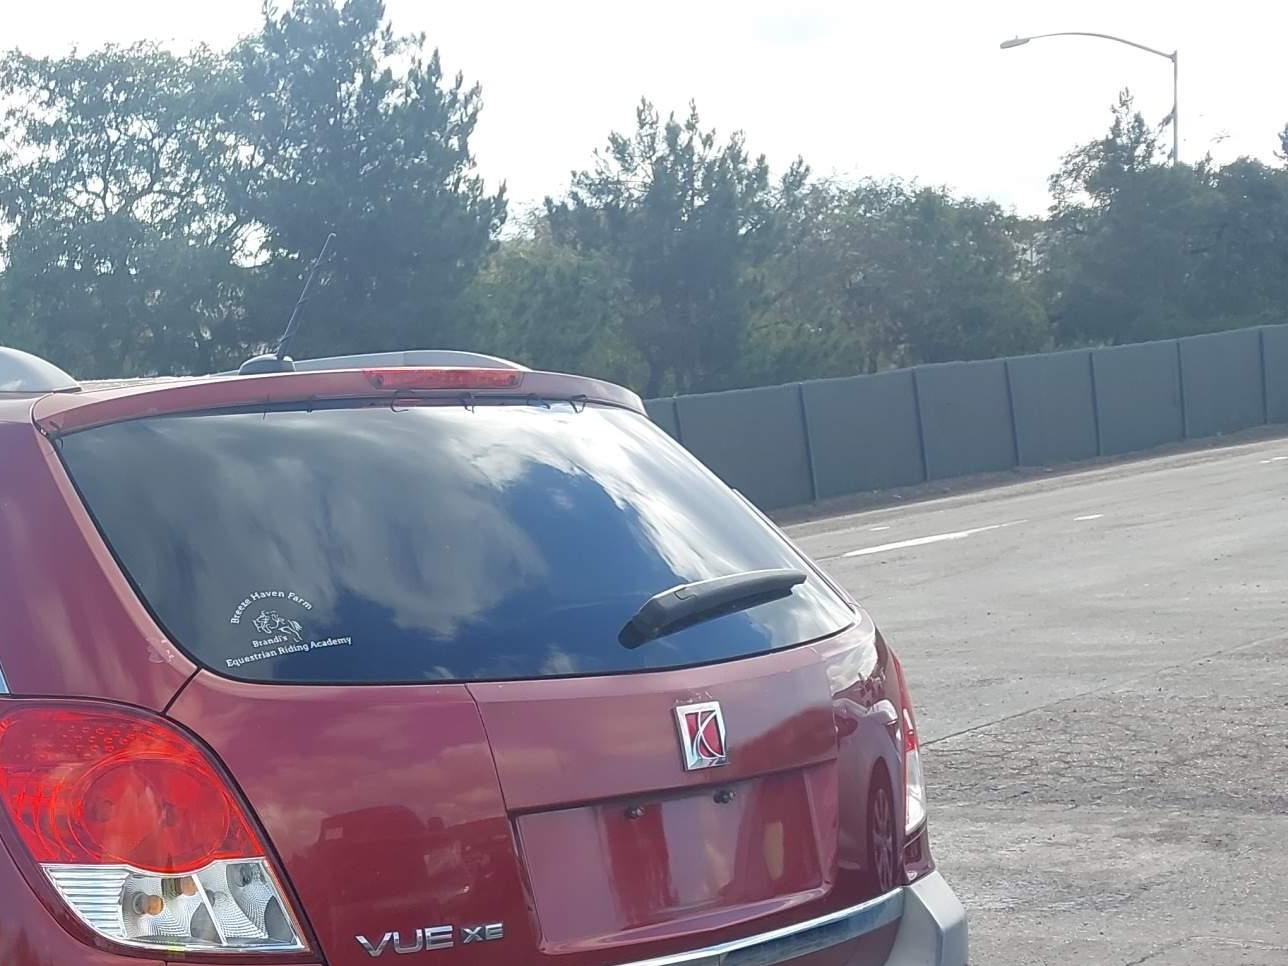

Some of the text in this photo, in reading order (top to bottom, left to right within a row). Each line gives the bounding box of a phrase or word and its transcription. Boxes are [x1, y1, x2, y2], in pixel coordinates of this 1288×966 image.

[230, 590, 312, 624] Breeze Haven Farm
[226, 636, 352, 667] Equestrian Riding Academy
[252, 635, 288, 648] Brandi's
[355, 923, 504, 957] VUE XE
